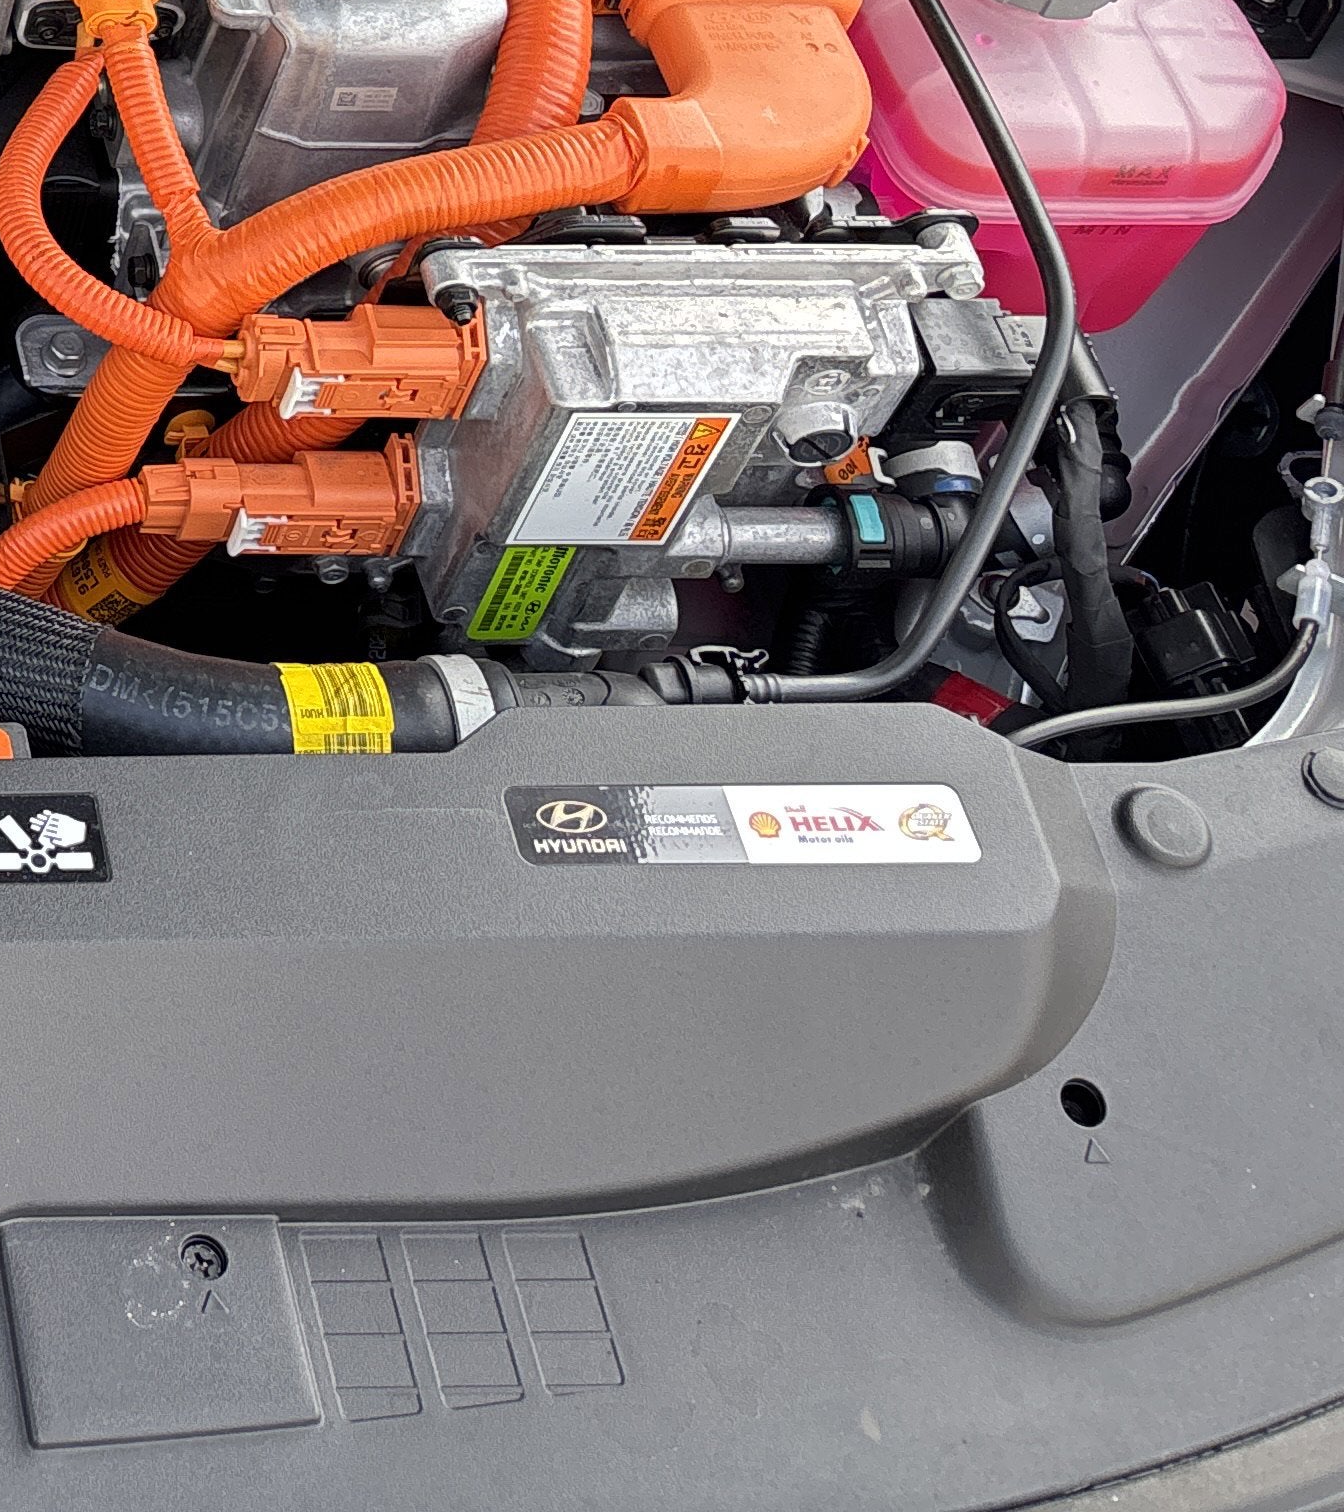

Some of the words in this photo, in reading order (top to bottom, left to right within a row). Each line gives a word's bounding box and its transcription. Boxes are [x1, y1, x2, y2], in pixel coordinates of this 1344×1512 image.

[1113, 165, 1172, 178] MAX
[675, 442, 711, 470] 경고
[644, 814, 718, 824] RECOMMENDS
[789, 815, 883, 831] HELIX
[647, 826, 724, 836] RECOMMANDE
[533, 838, 628, 853] HYUNDAI
[798, 835, 832, 843] Motor
[835, 835, 854, 843] oils
